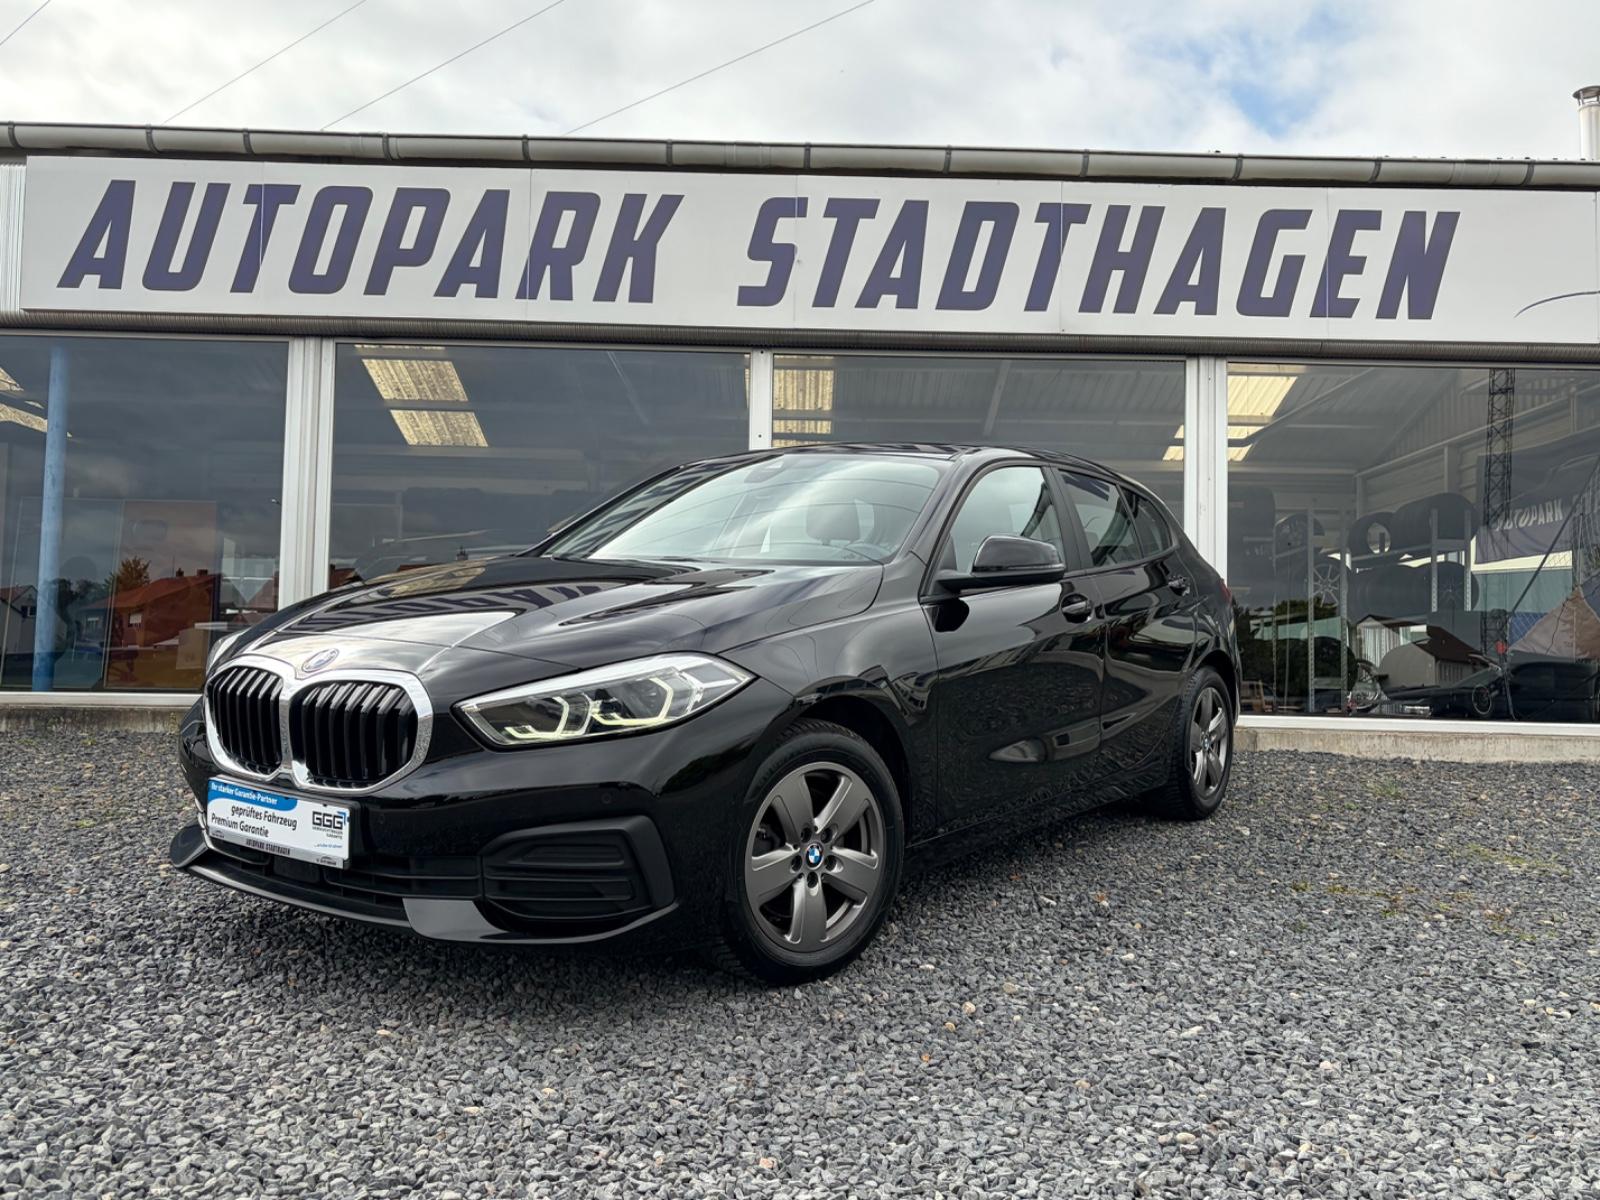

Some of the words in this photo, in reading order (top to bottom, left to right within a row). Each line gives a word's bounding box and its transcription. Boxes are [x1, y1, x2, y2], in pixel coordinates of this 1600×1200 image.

[56, 179, 684, 303] AUTOPARK
[736, 196, 1461, 320] STADTHAGEN
[211, 812, 238, 830] Premium
[239, 820, 269, 838] Garantie
[231, 805, 262, 820] geprüftes
[263, 810, 298, 831] Fahrzeug
[312, 811, 343, 830] GGG
